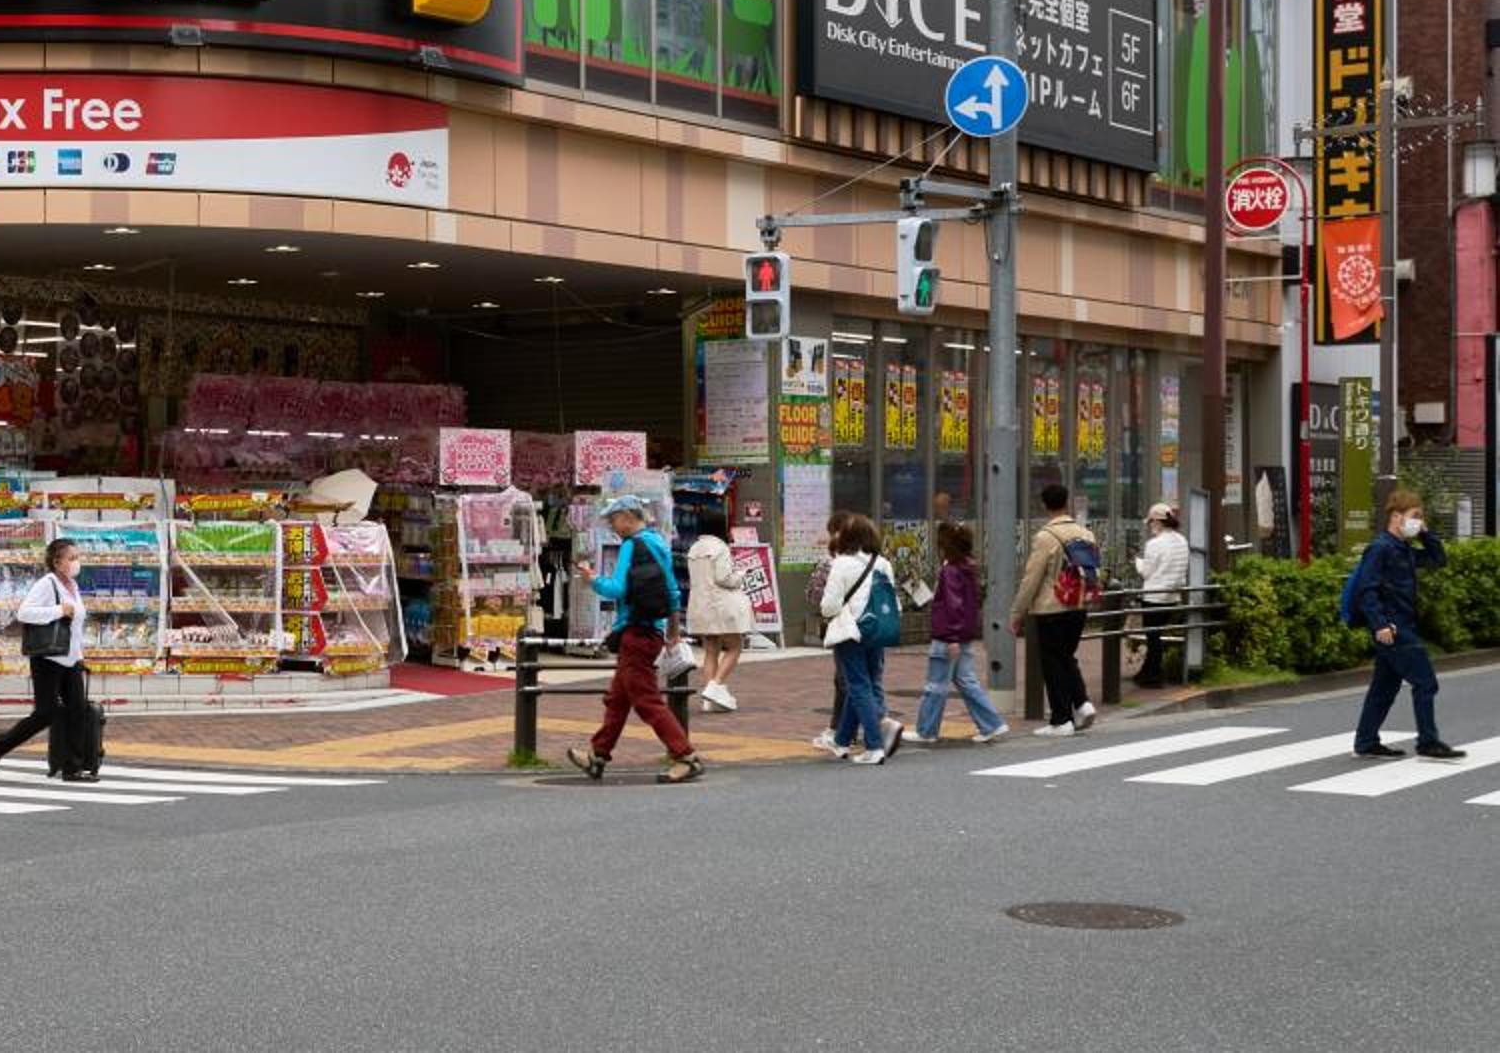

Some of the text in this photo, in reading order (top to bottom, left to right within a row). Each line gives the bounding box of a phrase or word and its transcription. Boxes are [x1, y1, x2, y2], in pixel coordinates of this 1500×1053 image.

[827, 21, 965, 70] Disk City Entertainm
[1121, 32, 1141, 64] 5F
[43, 88, 143, 132] Free
[1023, 71, 1102, 120] IPルーム
[1121, 80, 1141, 112] 6F
[1231, 186, 1284, 211] 消火栓
[779, 405, 817, 423] FLOOR
[780, 426, 817, 443] GUIDE
